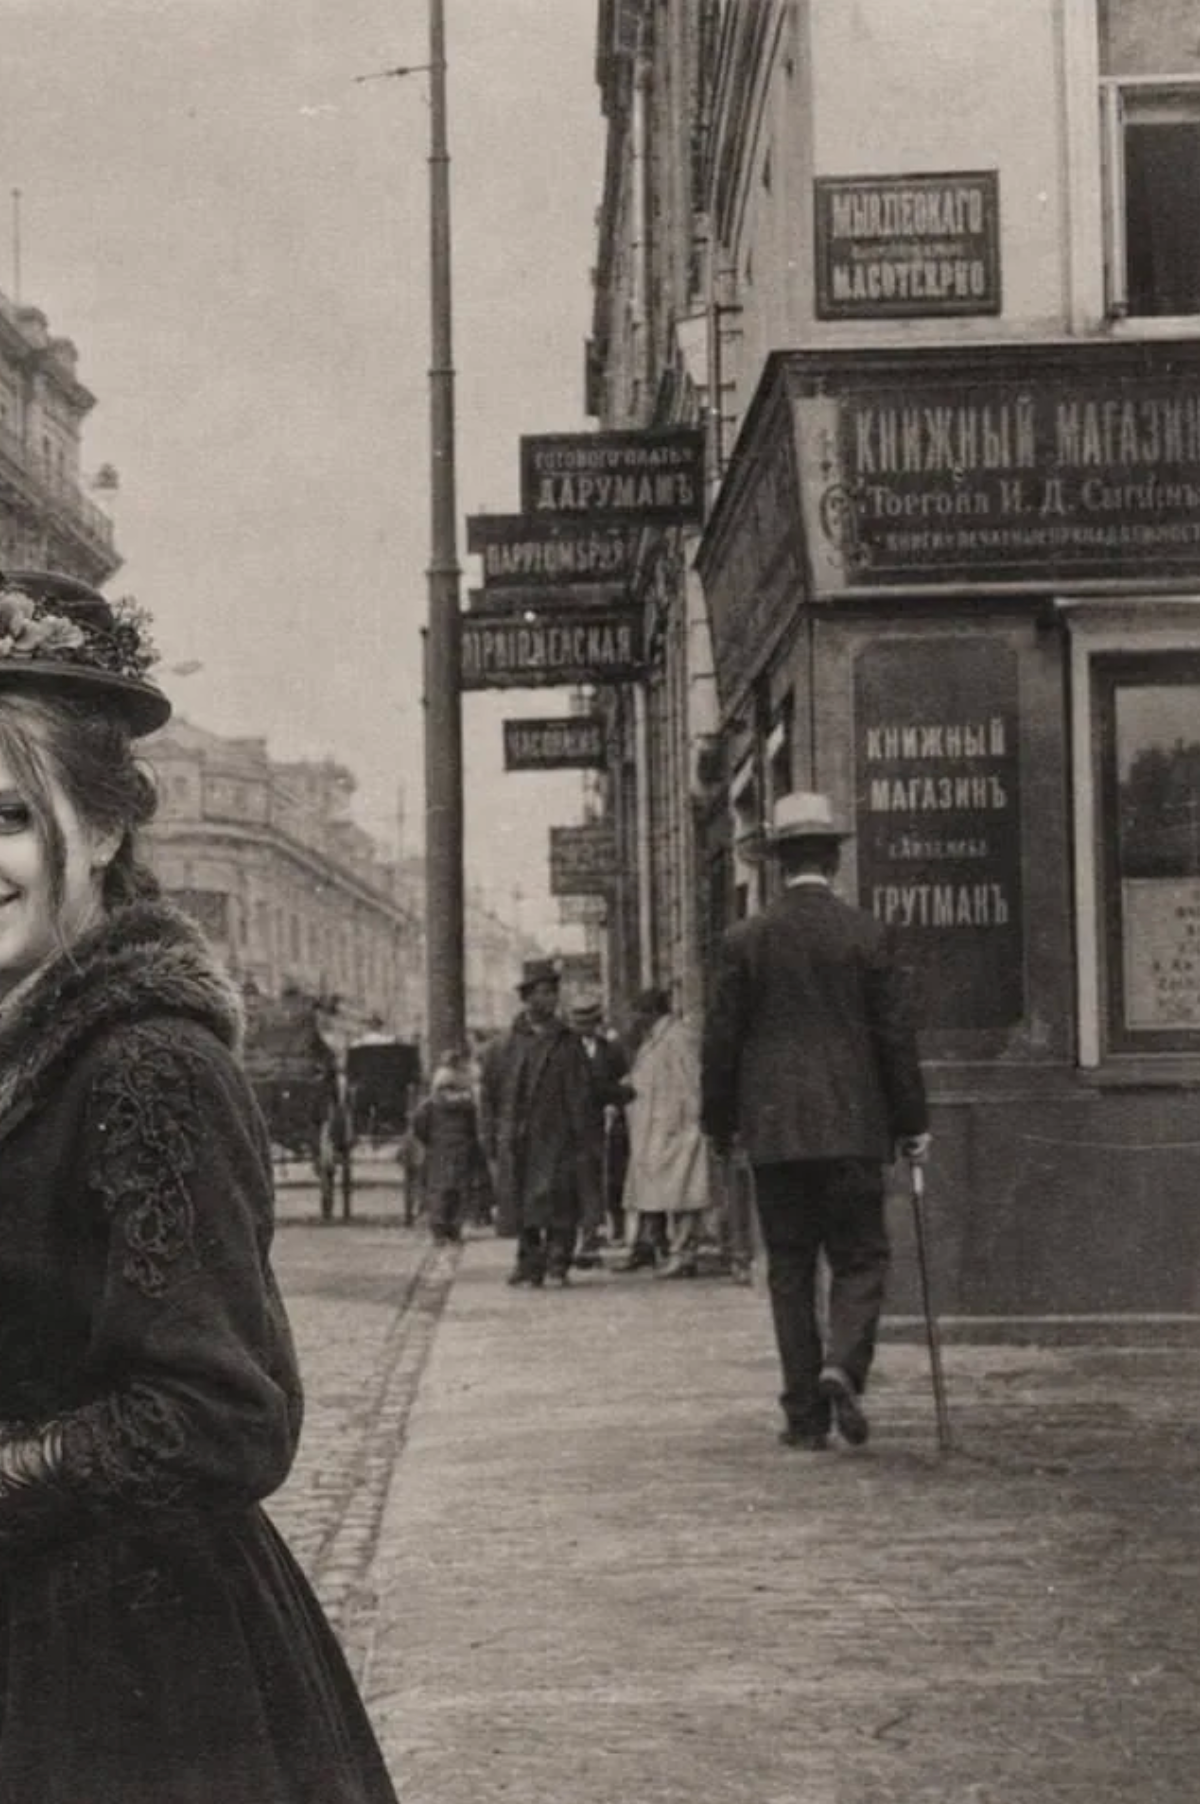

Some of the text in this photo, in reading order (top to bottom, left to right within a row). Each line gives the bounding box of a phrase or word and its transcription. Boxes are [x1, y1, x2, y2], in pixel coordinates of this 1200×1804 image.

[856, 396, 1036, 474] КНИЖНЫЙ
[867, 718, 1006, 760] КНИЖНЫЙ
[871, 776, 1008, 812] МАГАЗИНЪ
